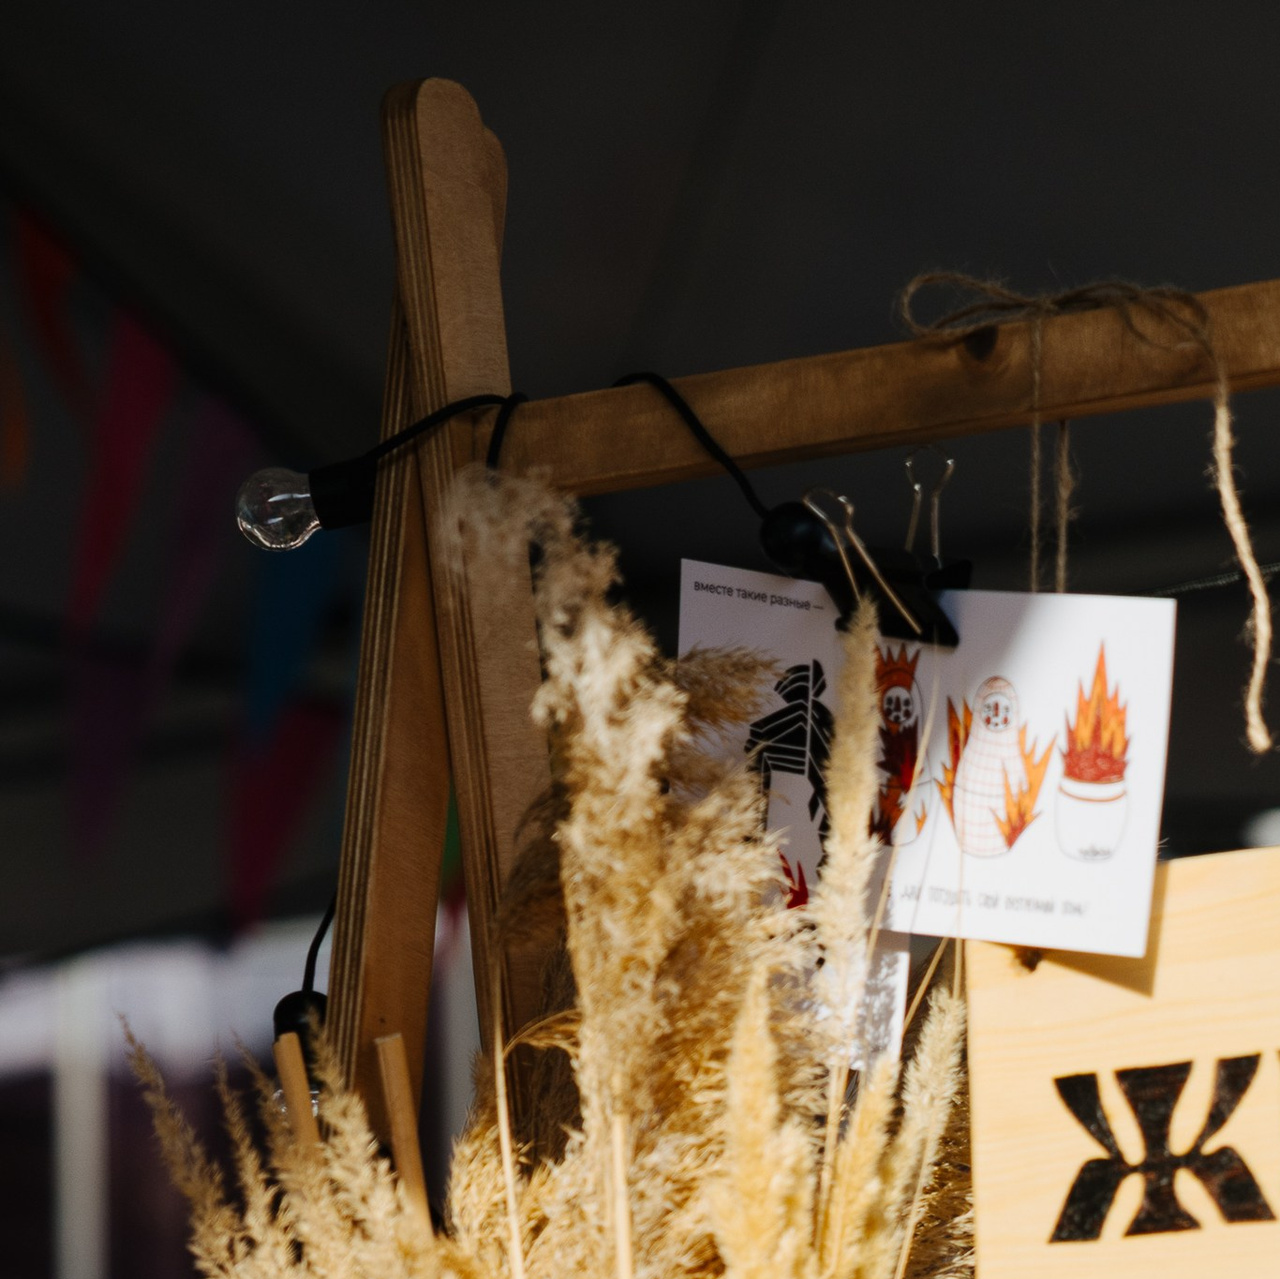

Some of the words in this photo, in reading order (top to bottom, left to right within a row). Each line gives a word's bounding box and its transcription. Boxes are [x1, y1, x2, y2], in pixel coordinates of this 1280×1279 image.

[693, 581, 734, 597] вместе
[736, 588, 768, 603] такие
[770, 594, 811, 611] разные
